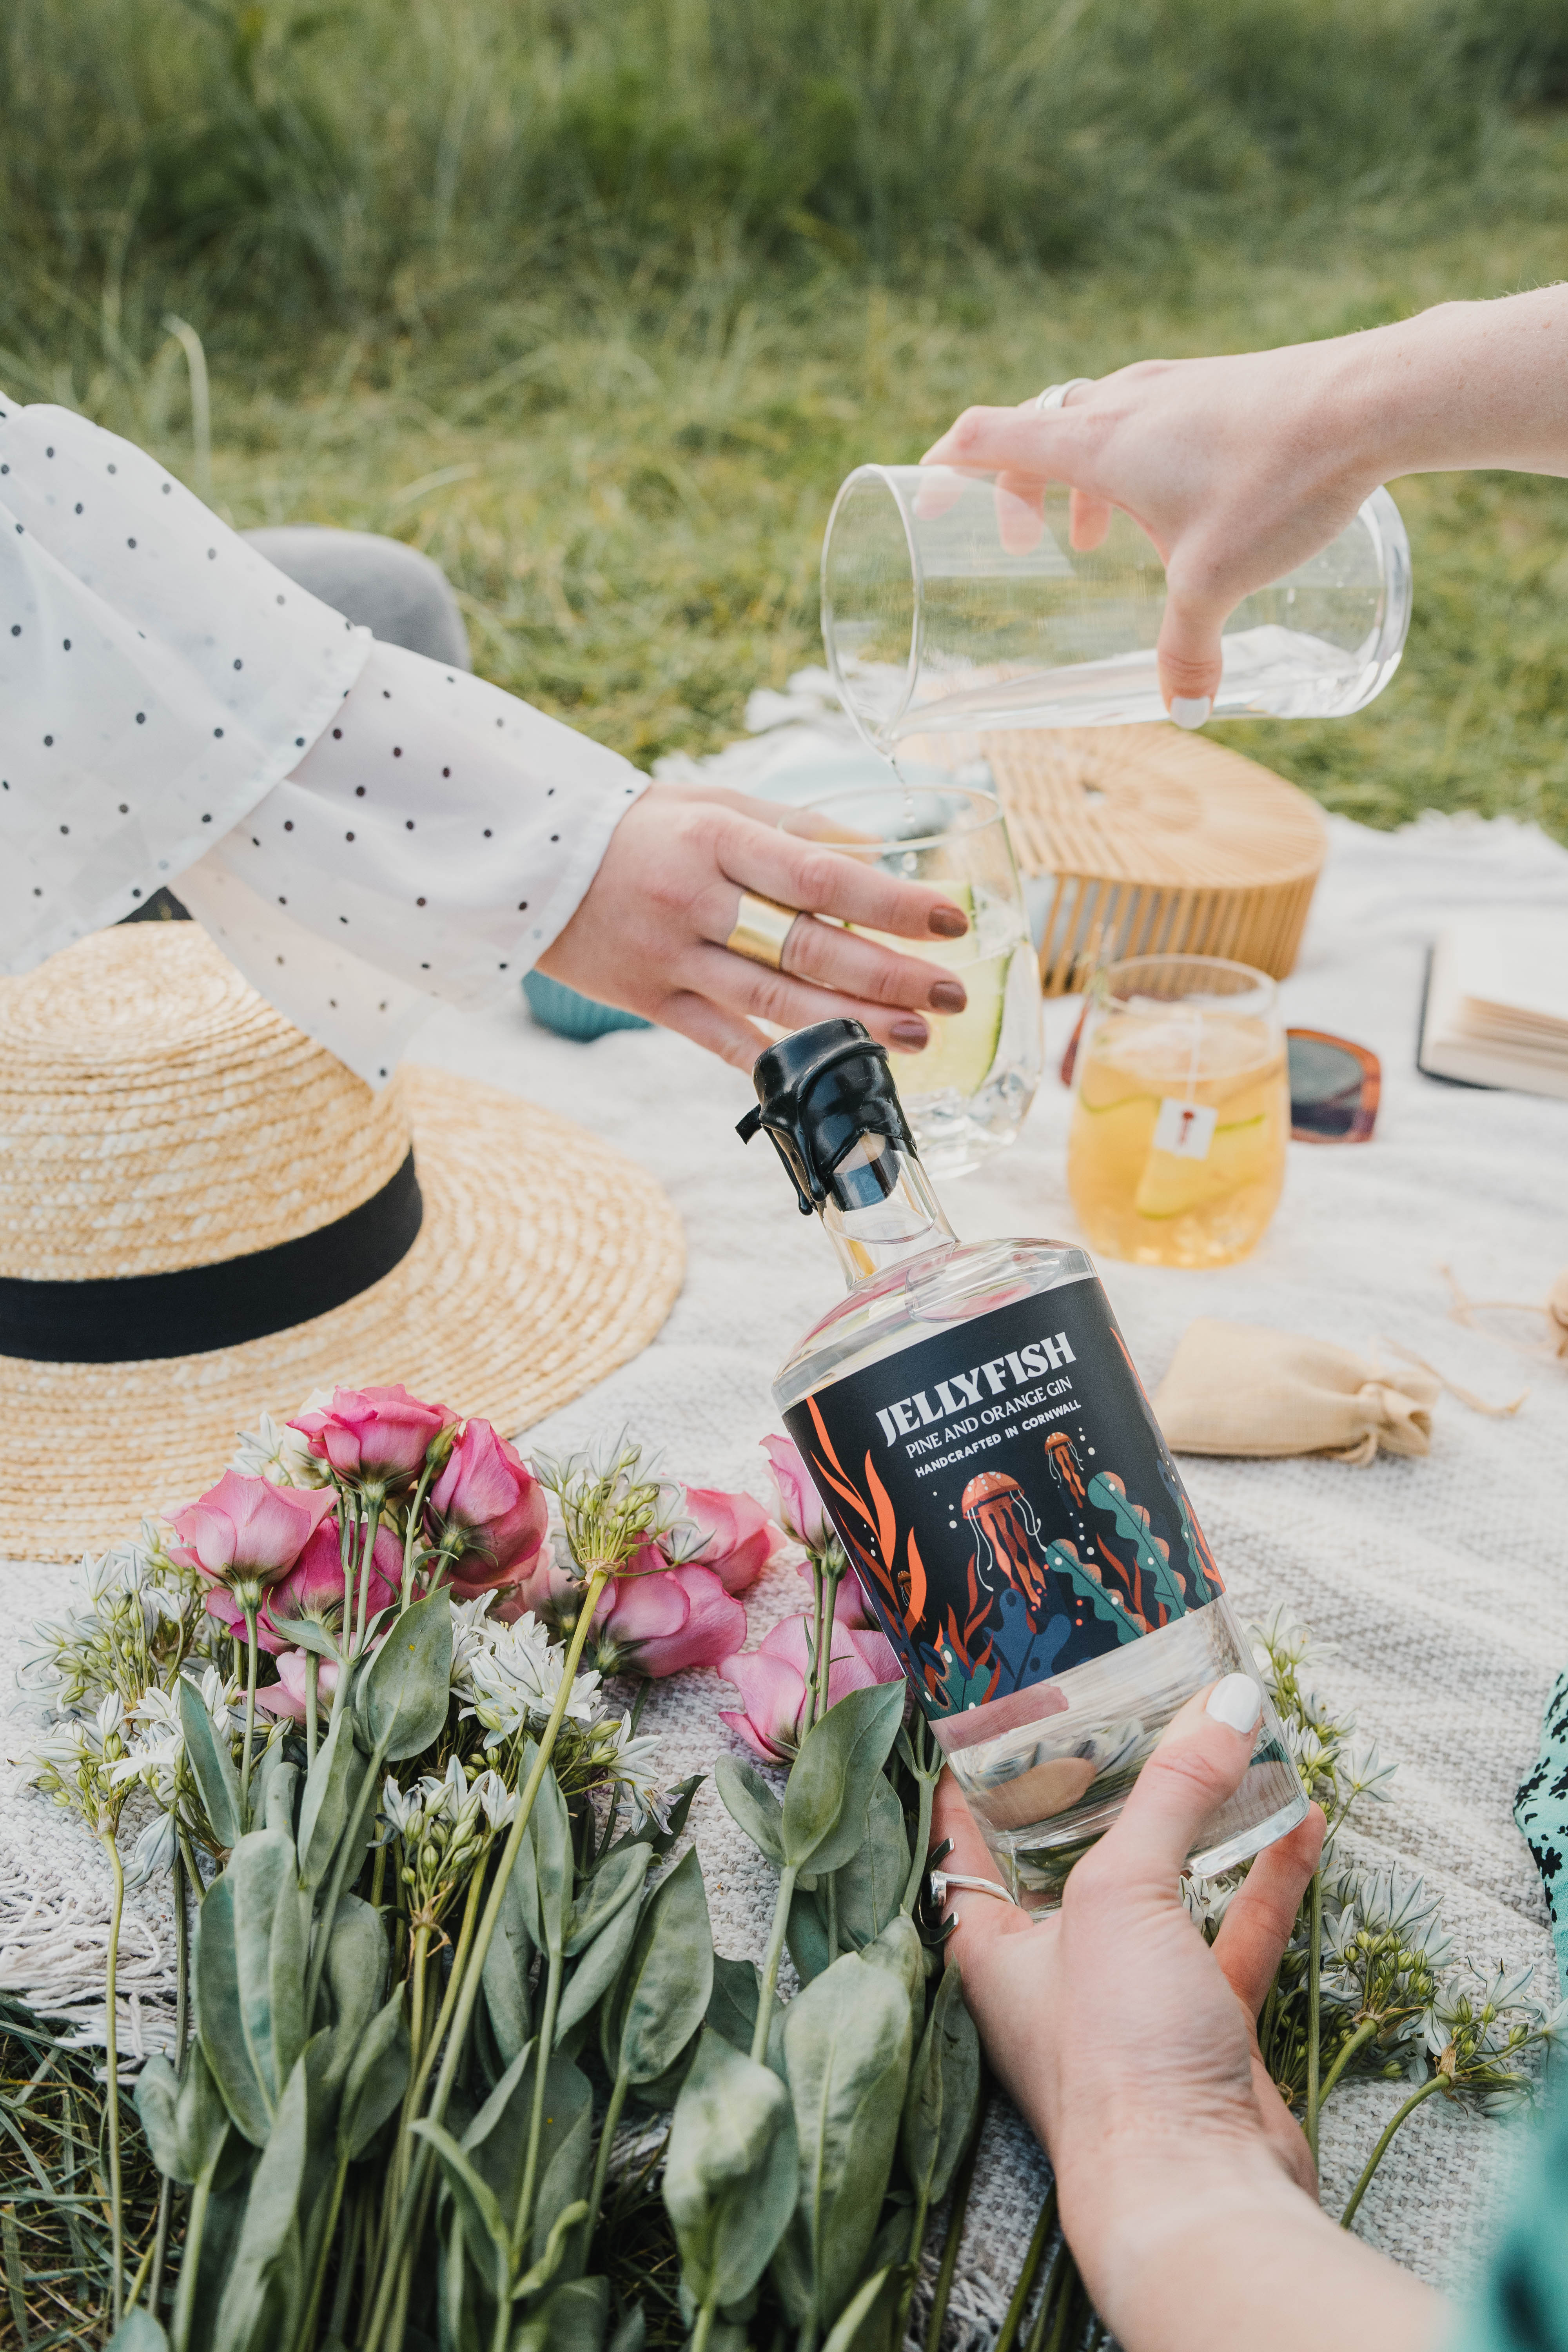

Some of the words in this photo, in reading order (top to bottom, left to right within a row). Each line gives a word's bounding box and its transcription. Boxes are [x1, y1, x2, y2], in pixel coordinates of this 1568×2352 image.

[876, 1332, 1076, 1447] JELLYFISH
[906, 1432, 942, 1458] PINE
[945, 1417, 978, 1443] AND
[981, 1387, 1047, 1424] ORANGE
[1047, 1376, 1072, 1396] GIN
[915, 1434, 1001, 1477] HANDCRAFTED
[1005, 1426, 1018, 1438] IN
[1022, 1400, 1081, 1430] CORNWALL
